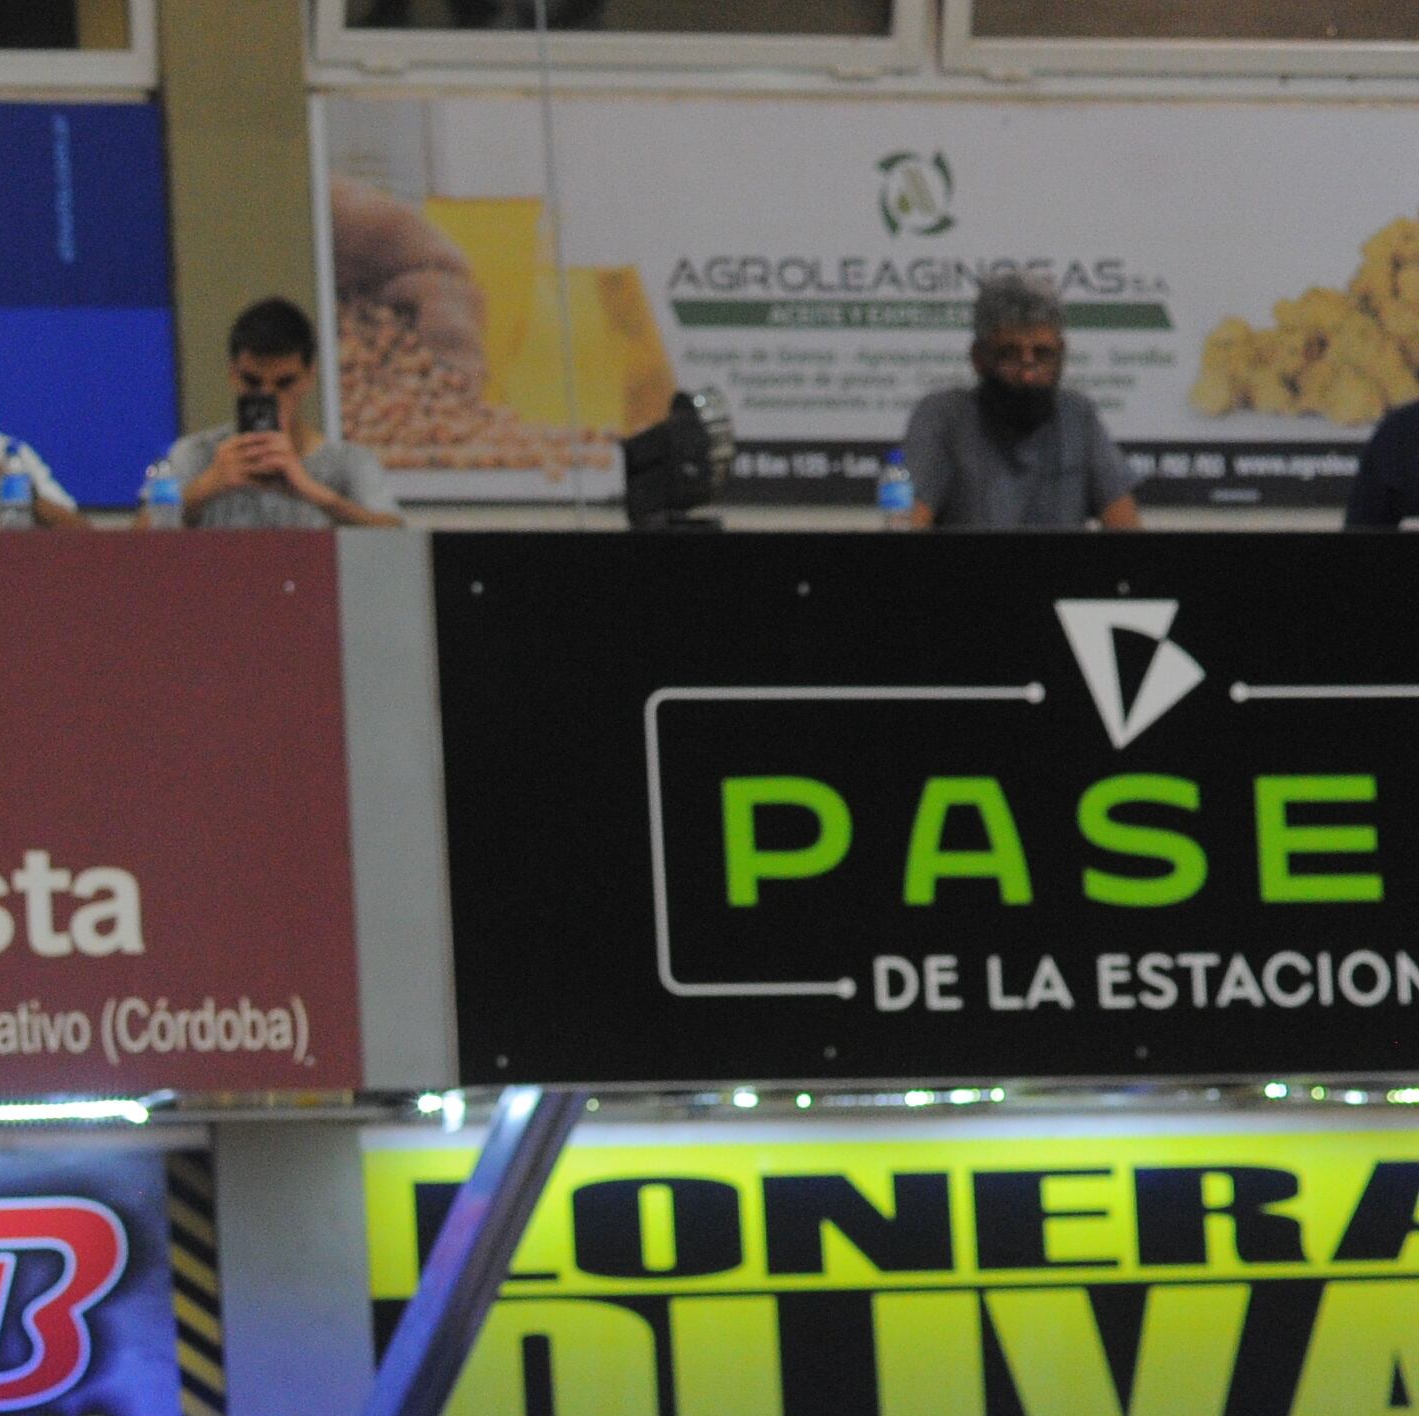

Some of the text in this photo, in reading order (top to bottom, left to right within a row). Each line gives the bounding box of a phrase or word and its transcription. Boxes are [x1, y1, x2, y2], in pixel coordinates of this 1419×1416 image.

[720, 773, 1385, 908] PASE
[872, 956, 963, 1013] DE
[987, 954, 1075, 1011] LA
[101, 996, 311, 1065] (Córdoba)
